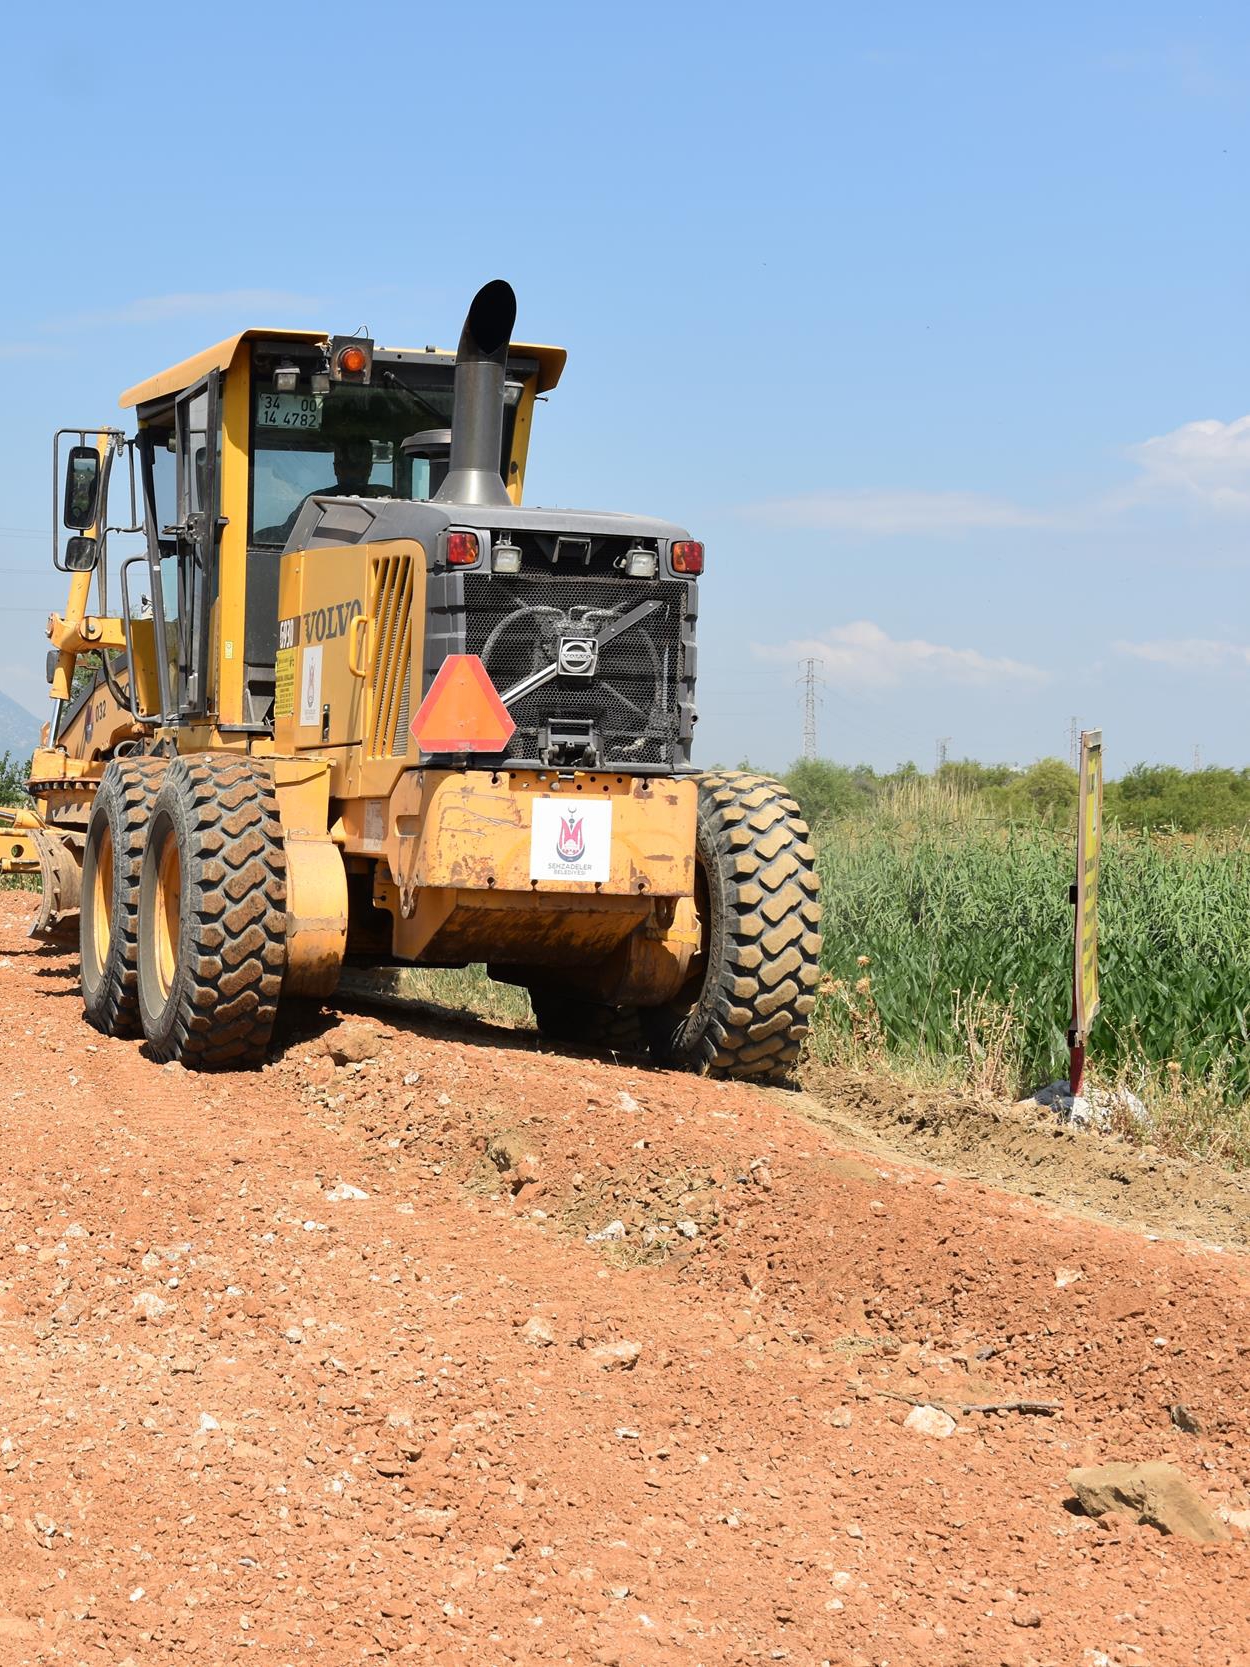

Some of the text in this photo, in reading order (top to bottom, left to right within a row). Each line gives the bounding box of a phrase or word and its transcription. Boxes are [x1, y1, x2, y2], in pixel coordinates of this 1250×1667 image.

[264, 396, 317, 412] 34 00
[264, 410, 317, 427] 14 4782
[303, 599, 362, 644] VOLVO
[95, 699, 106, 722] 032
